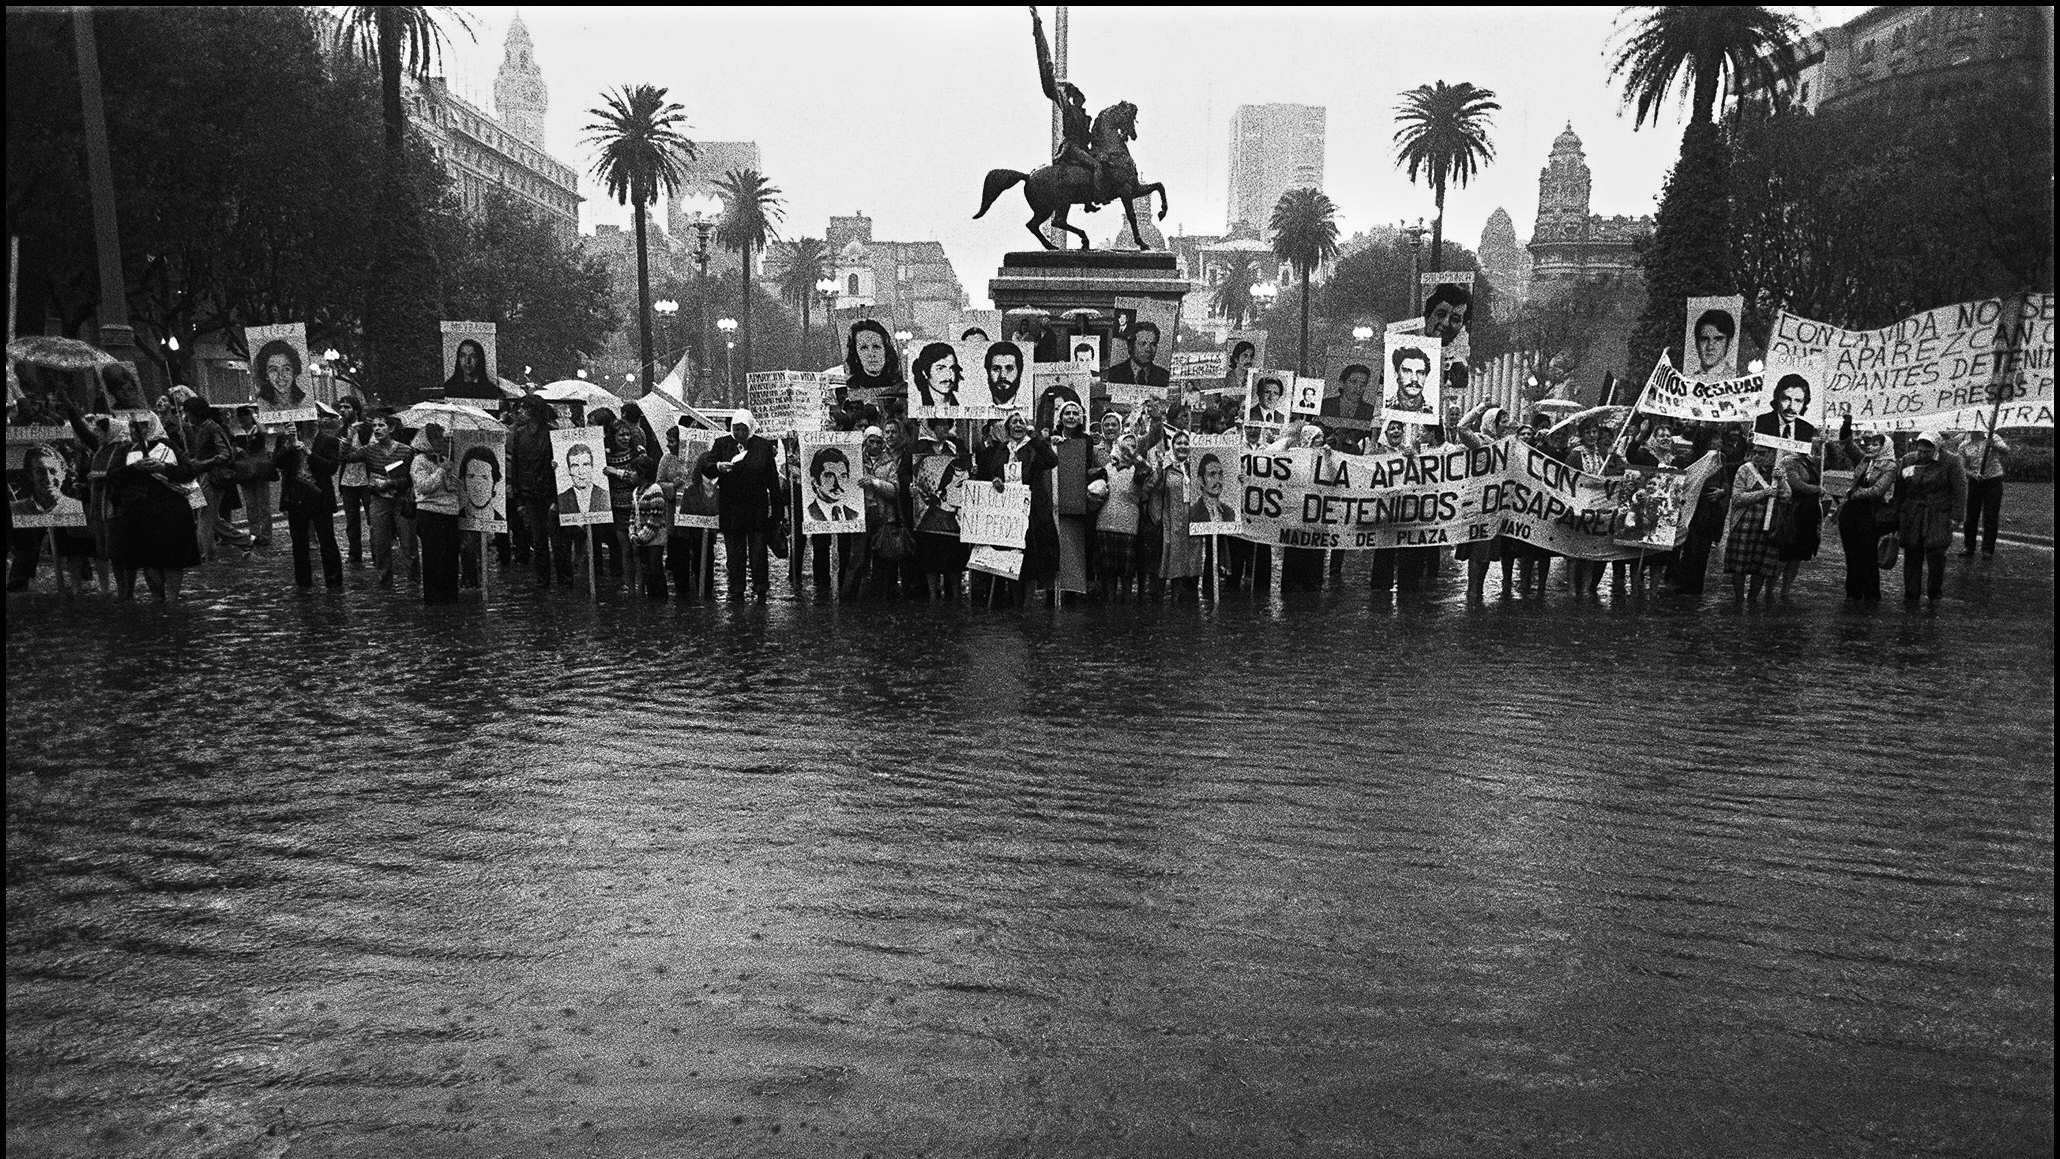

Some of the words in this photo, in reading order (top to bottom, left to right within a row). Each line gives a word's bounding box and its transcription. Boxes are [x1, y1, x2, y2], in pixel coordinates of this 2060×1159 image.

[1778, 313, 1834, 347] CON
[1838, 330, 1869, 348] LA
[1878, 312, 1937, 346] VIDA
[1957, 302, 2002, 331] NO
[1836, 322, 2034, 371] APAREZCAN
[1860, 399, 1874, 417] A
[1881, 394, 1924, 416] LOS
[1937, 382, 2028, 408] PRESOS
[803, 431, 851, 444] CHAVEZ
[1313, 455, 1350, 489] LA
[1370, 441, 1509, 489] APARICION
[1527, 450, 1581, 498] CON
[962, 511, 979, 537] NI
[1241, 486, 1283, 518] OS
[1302, 491, 1459, 525] DETENIDOS
[1279, 528, 1340, 547] MADRES
[1355, 531, 1376, 547] DE
[1396, 528, 1448, 546] PLAZA
[1469, 523, 1488, 540] DE
[1499, 518, 1531, 540] MAYO
